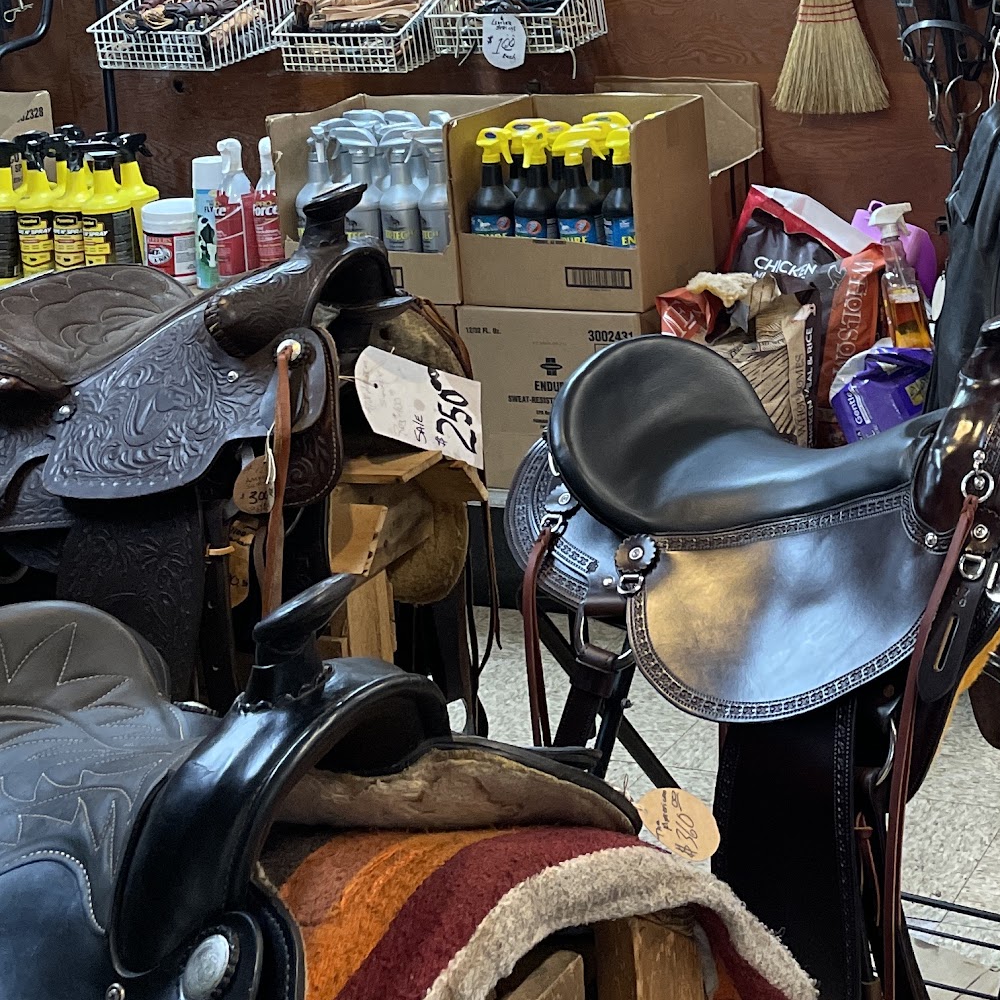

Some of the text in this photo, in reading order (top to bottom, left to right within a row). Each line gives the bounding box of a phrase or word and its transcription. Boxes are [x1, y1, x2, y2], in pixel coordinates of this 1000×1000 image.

[754, 256, 818, 279] CHICKEN
[588, 330, 633, 343] 3002431
[806, 327, 814, 354] RICE
[534, 380, 564, 392] ENDU
[846, 391, 864, 425] Gentle
